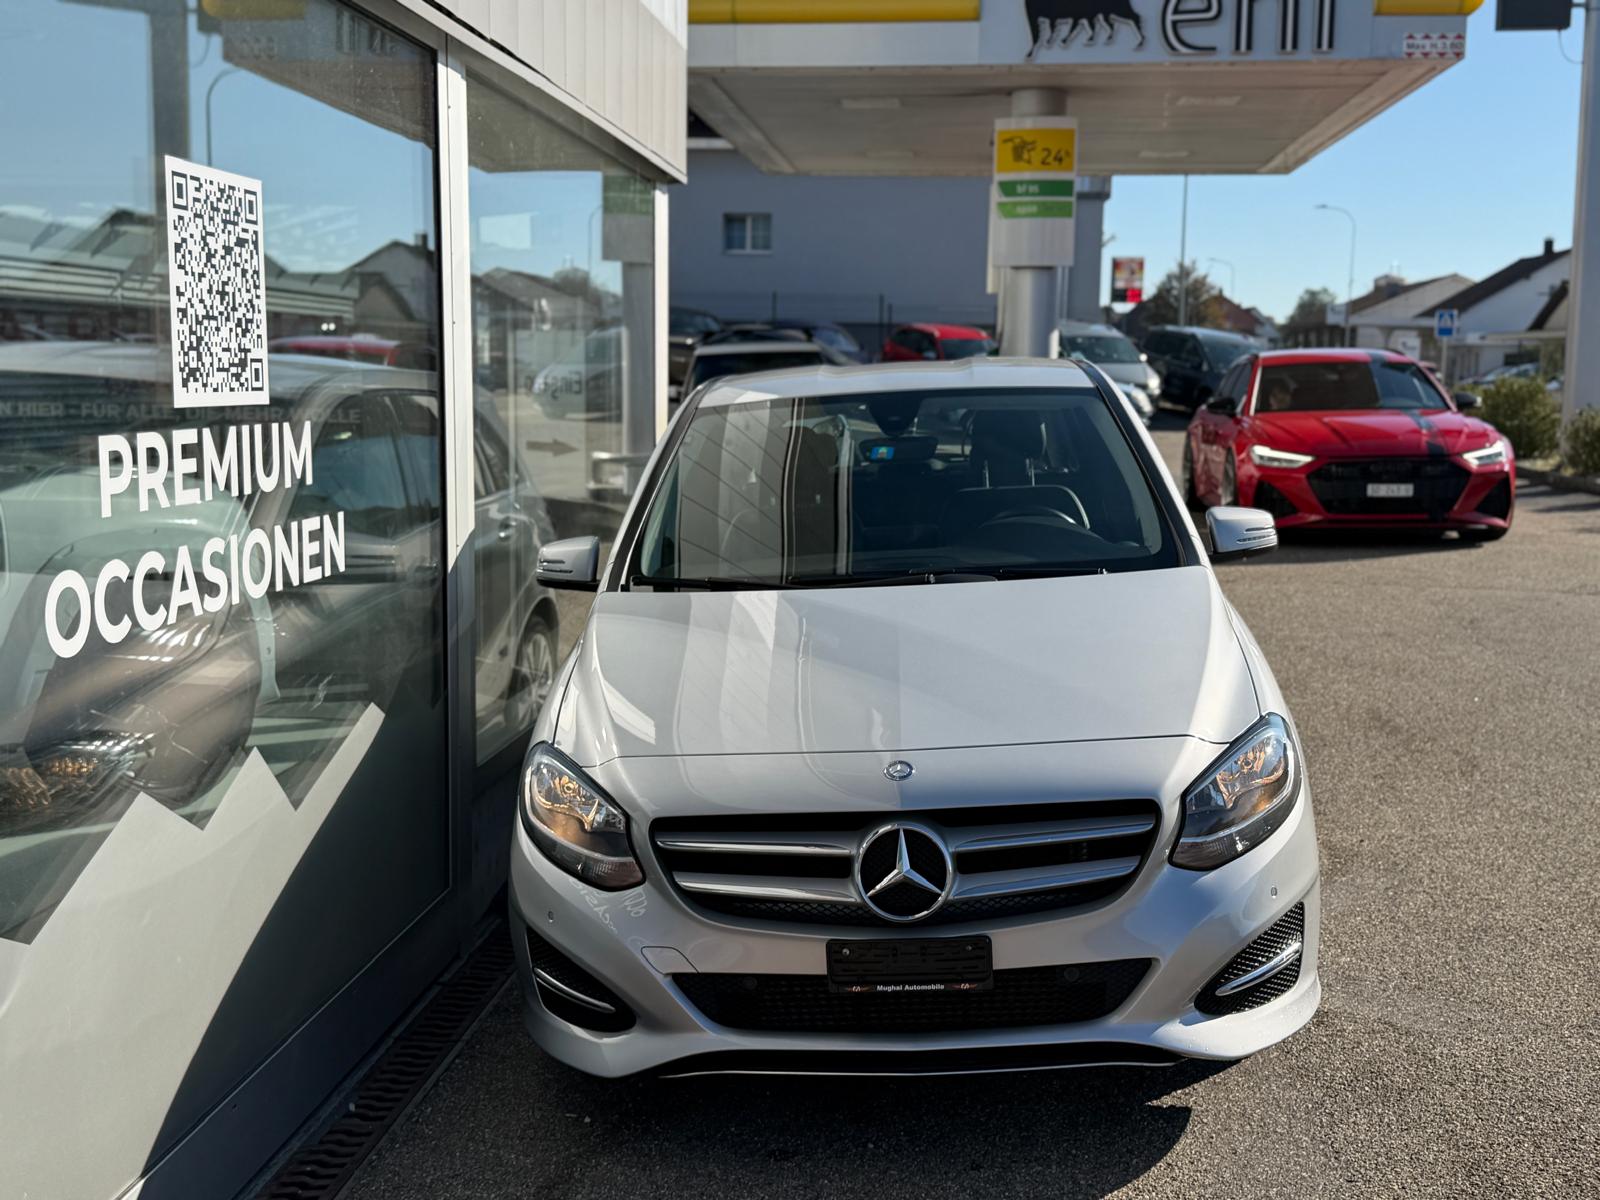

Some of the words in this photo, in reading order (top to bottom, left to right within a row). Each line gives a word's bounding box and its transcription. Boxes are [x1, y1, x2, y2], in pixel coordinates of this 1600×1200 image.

[98, 421, 313, 518] PREMIUM
[45, 511, 346, 658] OCCASIONEN
[876, 984, 903, 992] Mughal
